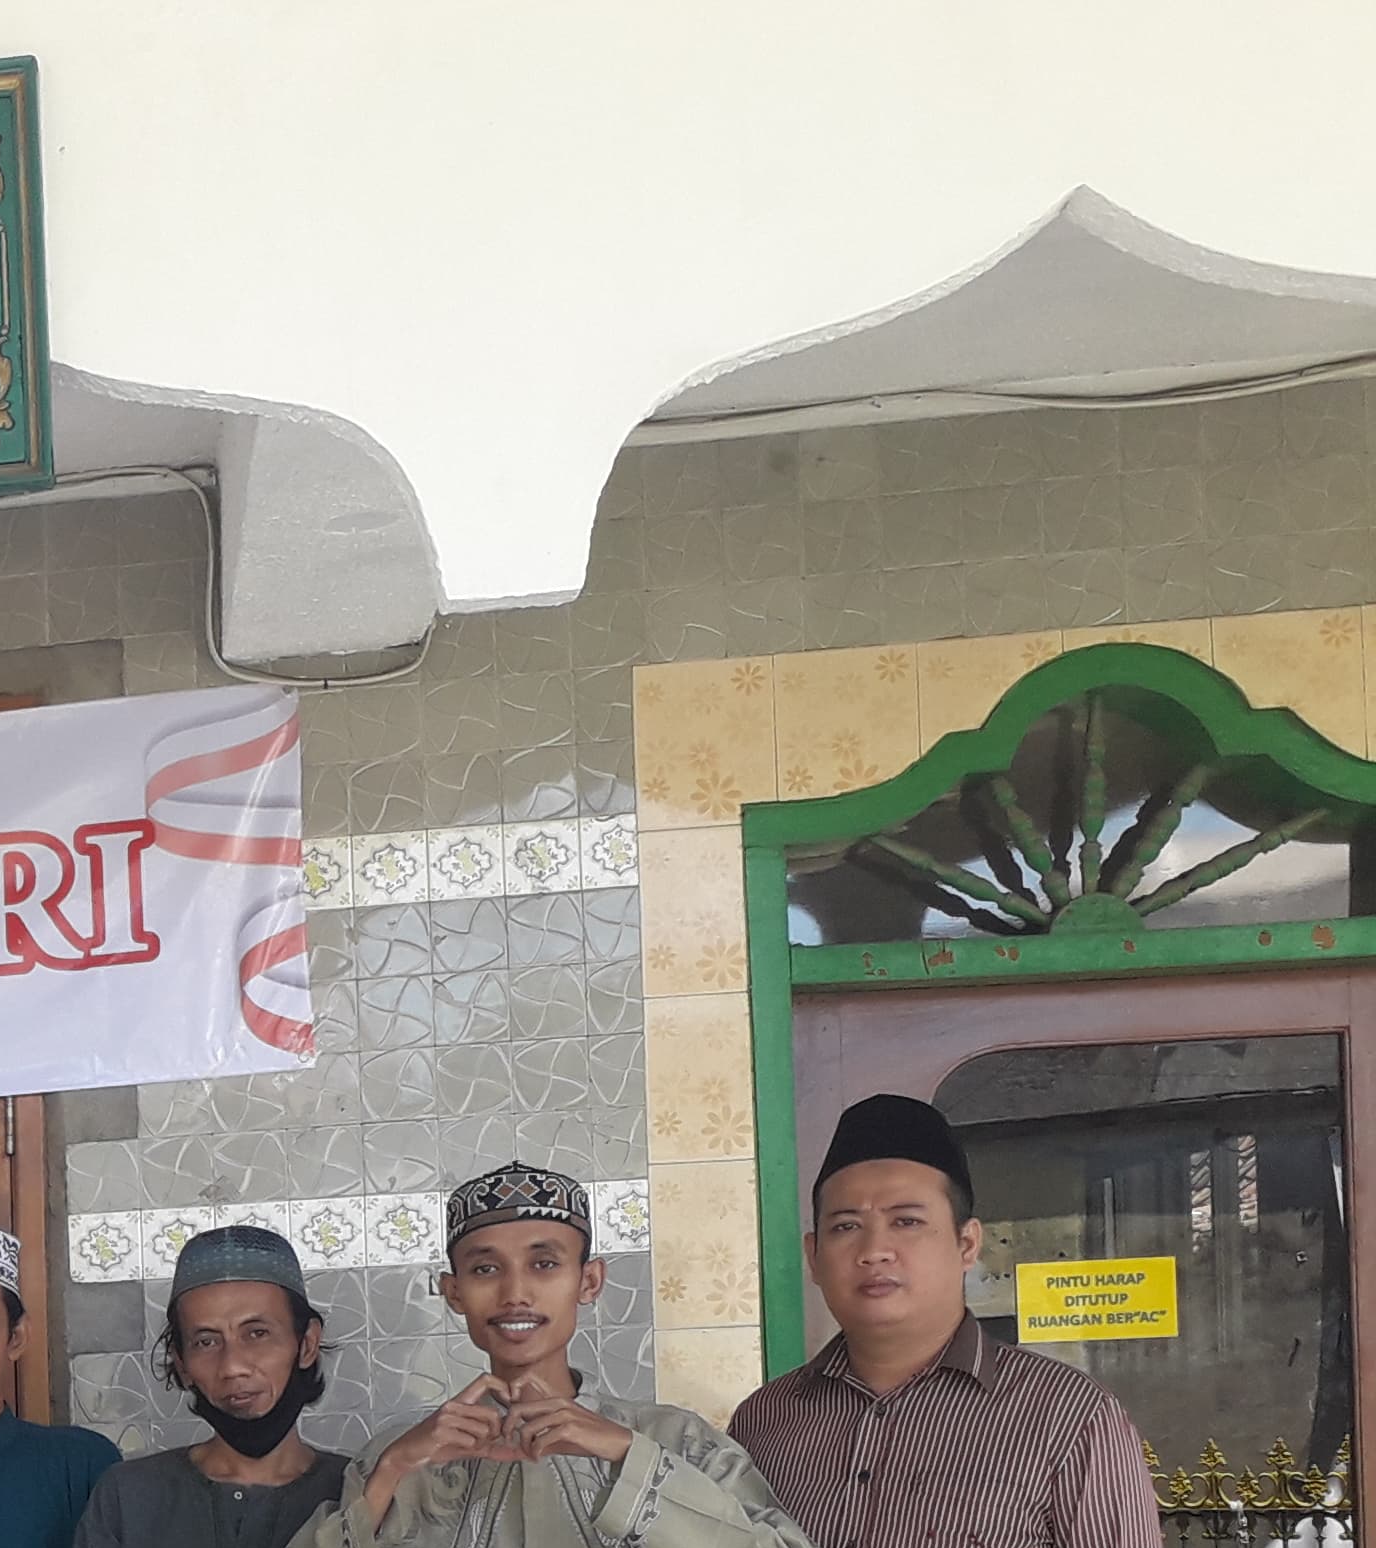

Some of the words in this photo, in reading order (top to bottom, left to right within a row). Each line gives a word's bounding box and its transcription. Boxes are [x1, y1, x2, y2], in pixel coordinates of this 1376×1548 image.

[1046, 1276, 1091, 1289] PINTU
[1095, 1273, 1145, 1286] HARAP
[1064, 1293, 1129, 1307] DITUTUP
[1028, 1315, 1102, 1329] RUANGAN
